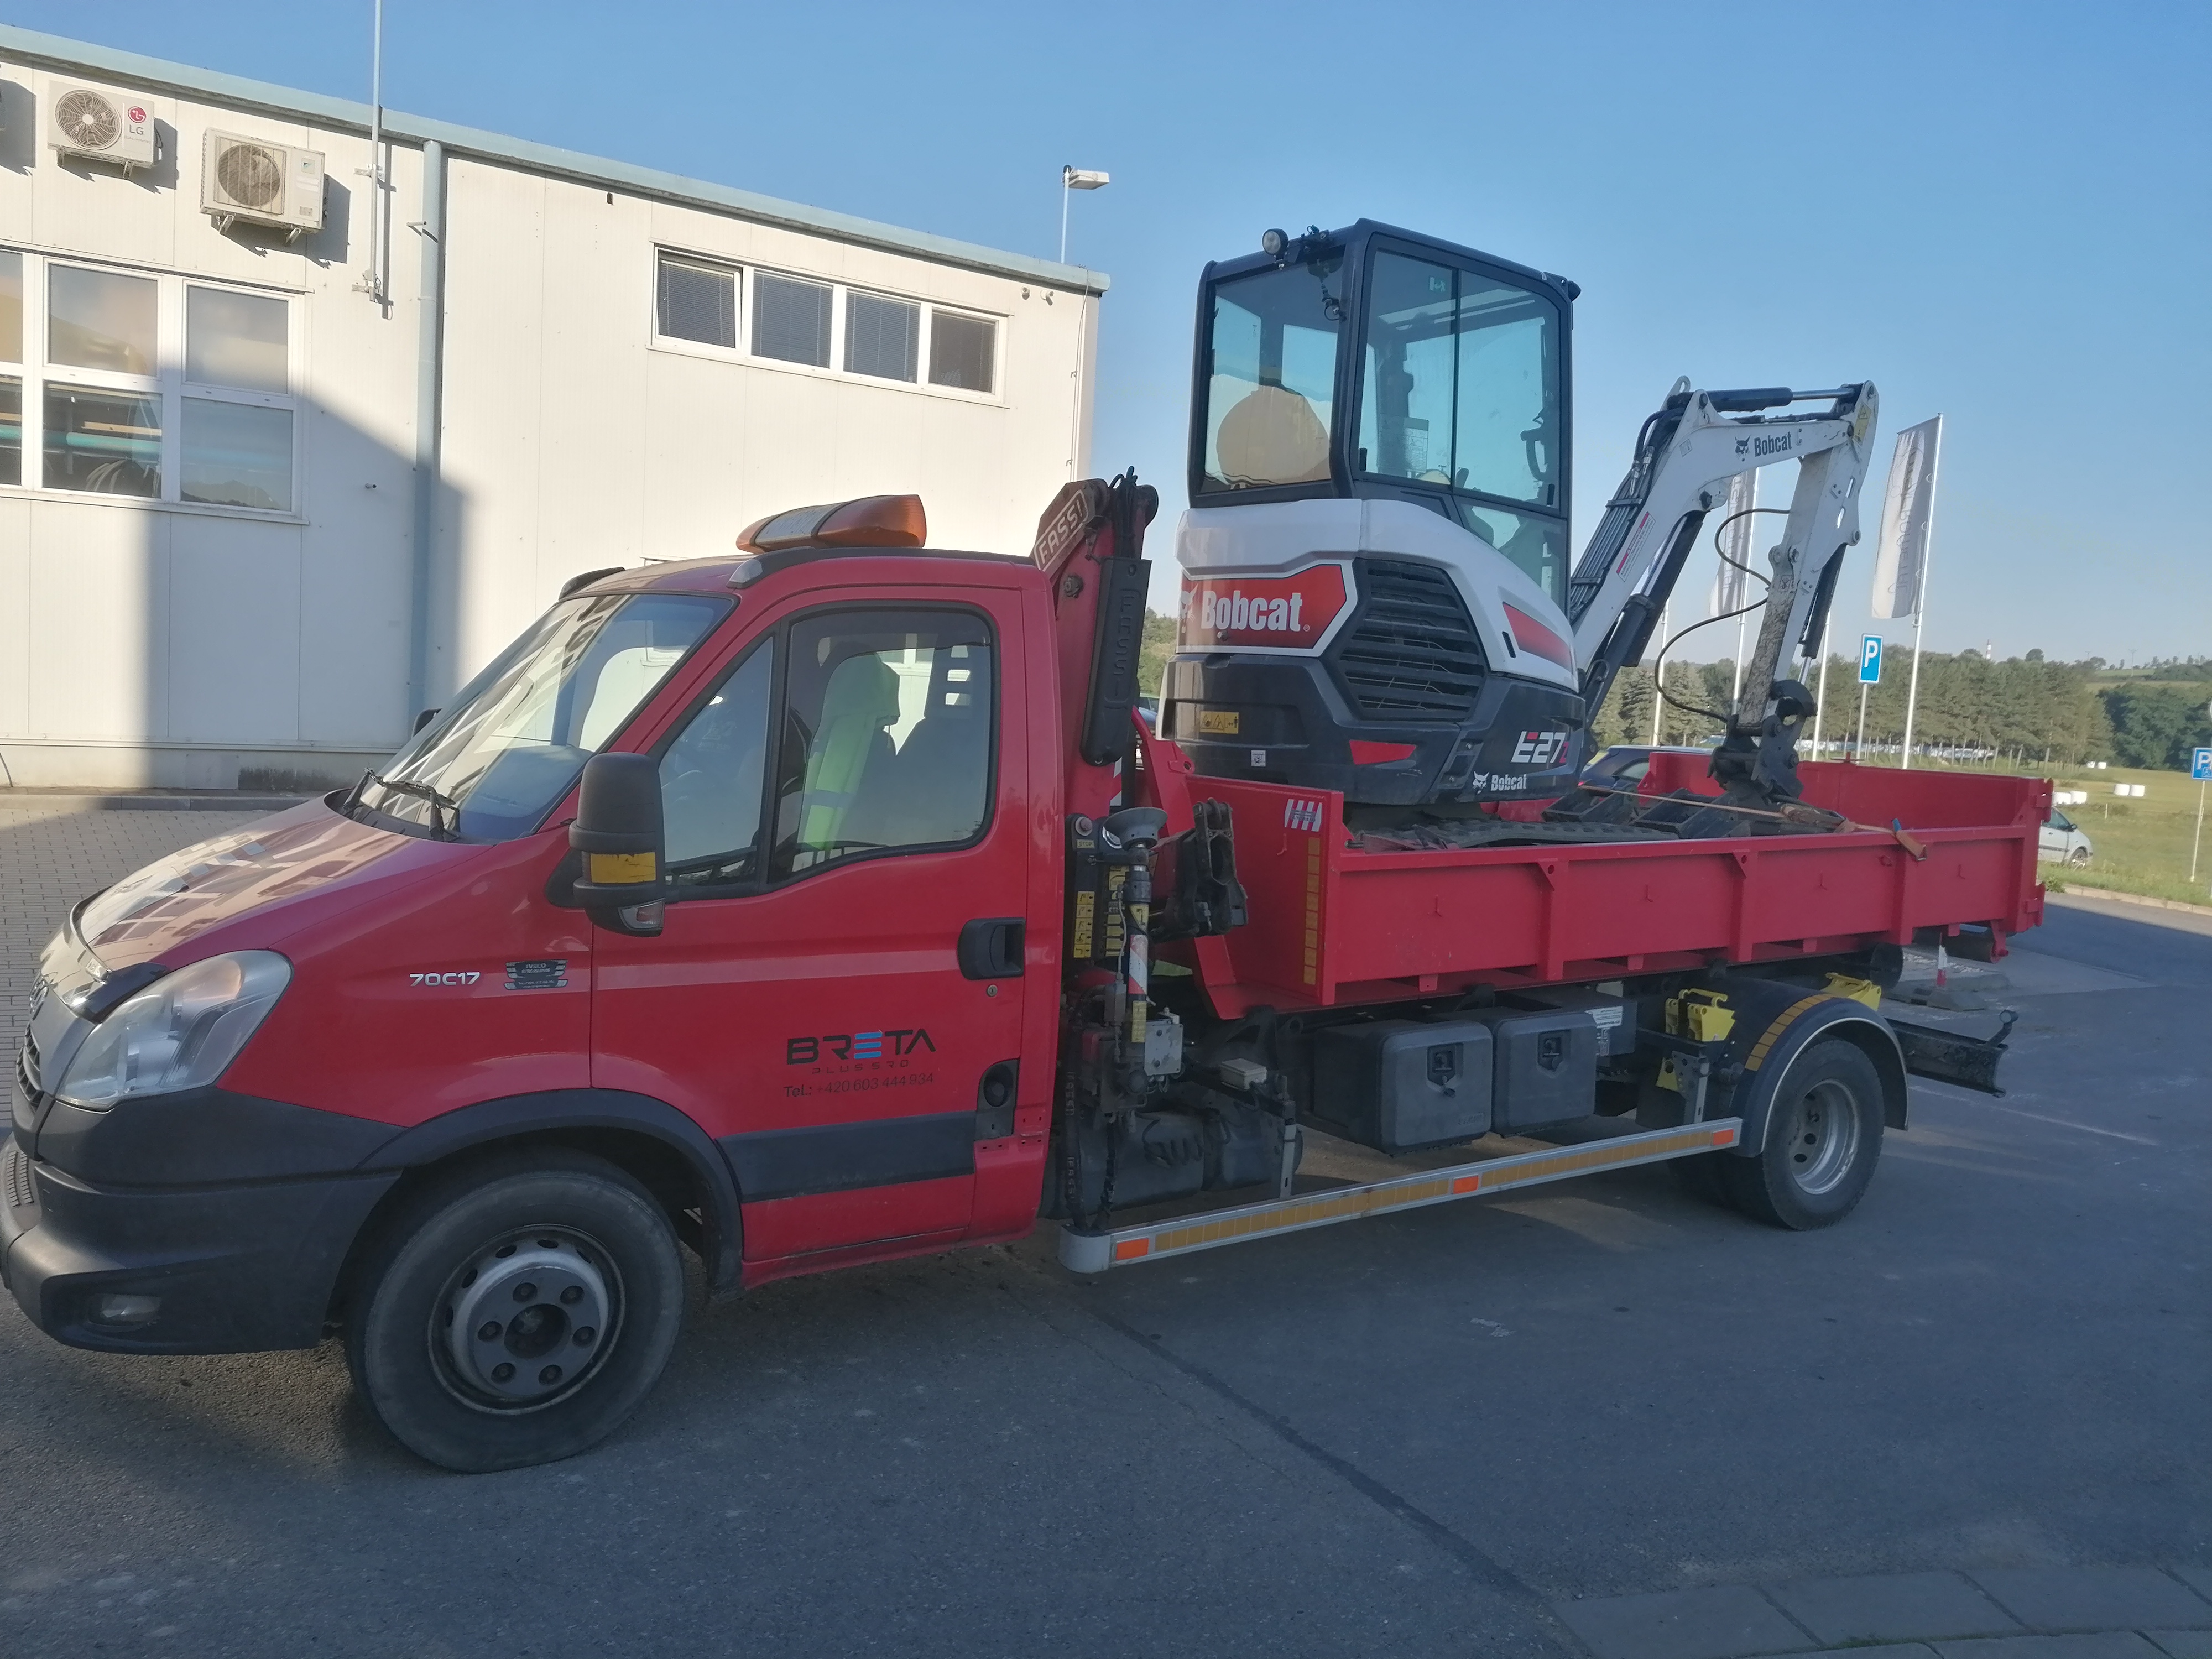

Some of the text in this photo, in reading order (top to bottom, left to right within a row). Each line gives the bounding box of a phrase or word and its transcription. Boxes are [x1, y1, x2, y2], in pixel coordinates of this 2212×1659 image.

[129, 124, 144, 135] LG
[1754, 431, 1792, 457] Bobcat
[1039, 499, 1083, 565] FASSI
[1201, 590, 1303, 632] Bobcat
[1113, 596, 1135, 697] FASSI
[1864, 640, 1879, 668] P
[2197, 752, 2211, 770] P
[1491, 774, 1527, 791] Bobcat
[410, 972, 481, 987] 70C17
[786, 1028, 937, 1065] BRETA
[812, 1063, 863, 1075] PLUS
[784, 1072, 934, 1097] Tel.: +420 603 444 934
